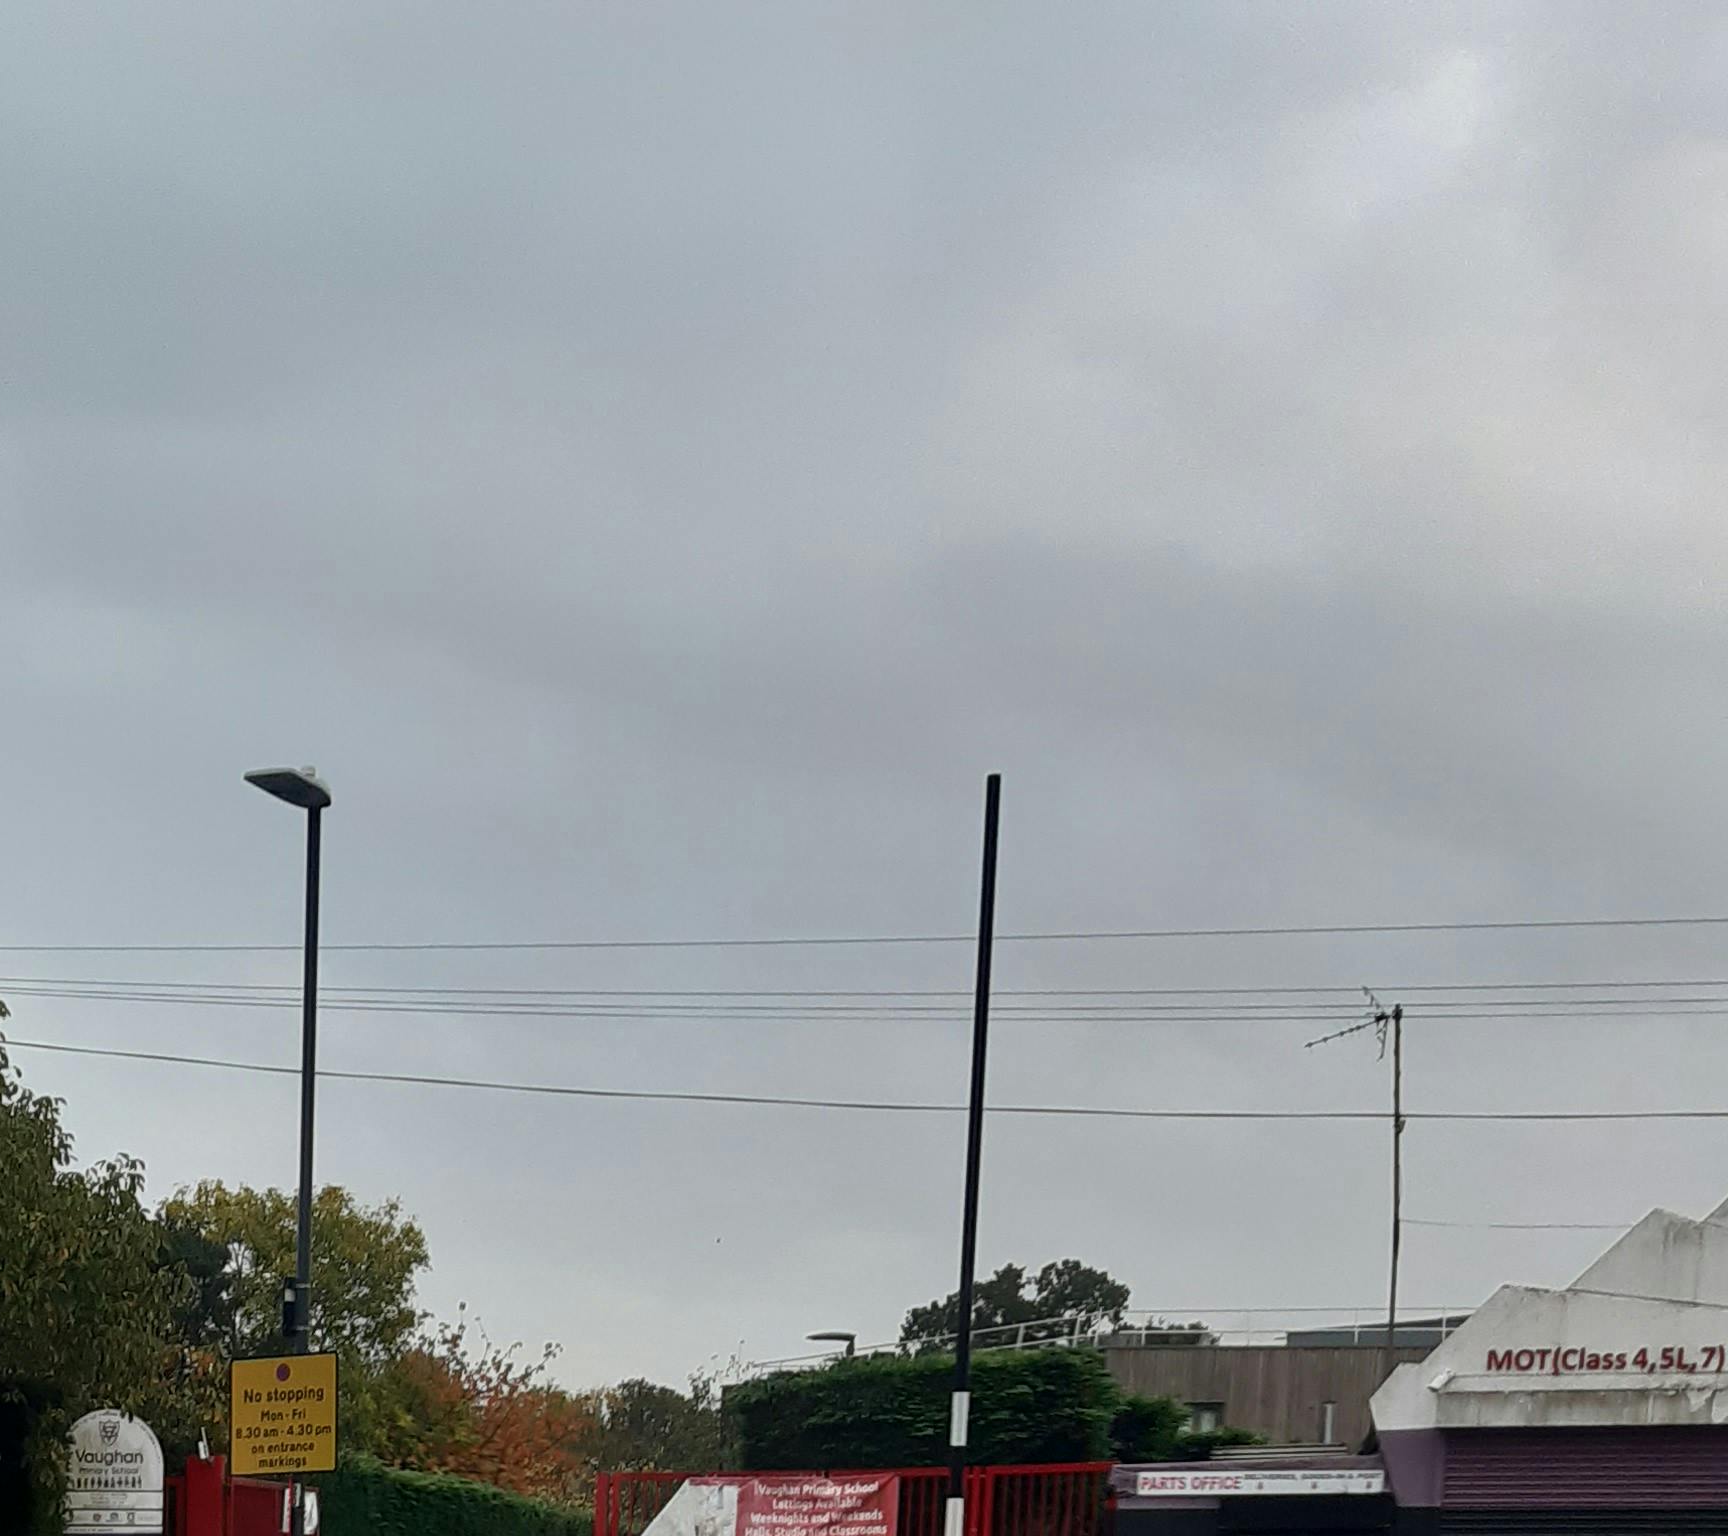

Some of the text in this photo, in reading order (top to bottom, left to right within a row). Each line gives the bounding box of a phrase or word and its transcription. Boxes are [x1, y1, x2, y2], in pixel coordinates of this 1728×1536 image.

[1486, 1346, 1627, 1376] MOT(Class
[243, 1386, 324, 1404] No stopping
[260, 1410, 284, 1422] Mon
[292, 1408, 306, 1420] Fri
[235, 1427, 261, 1439] 8.30
[263, 1428, 279, 1438] am
[286, 1424, 313, 1436] 4.30
[315, 1425, 332, 1436] pm
[251, 1442, 315, 1454] on entrance
[75, 1449, 144, 1466] Vaughan
[258, 1456, 307, 1468] markings
[79, 1466, 139, 1475] Primary School
[758, 1481, 880, 1497] Vaughan Primary School
[1140, 1475, 1242, 1491] PARTS OFFICE
[772, 1496, 863, 1511] Lettings Available
[751, 1509, 884, 1525] Weeknights and Weekends
[808, 1525, 828, 1536] and
[829, 1524, 888, 1536] Classrooms
